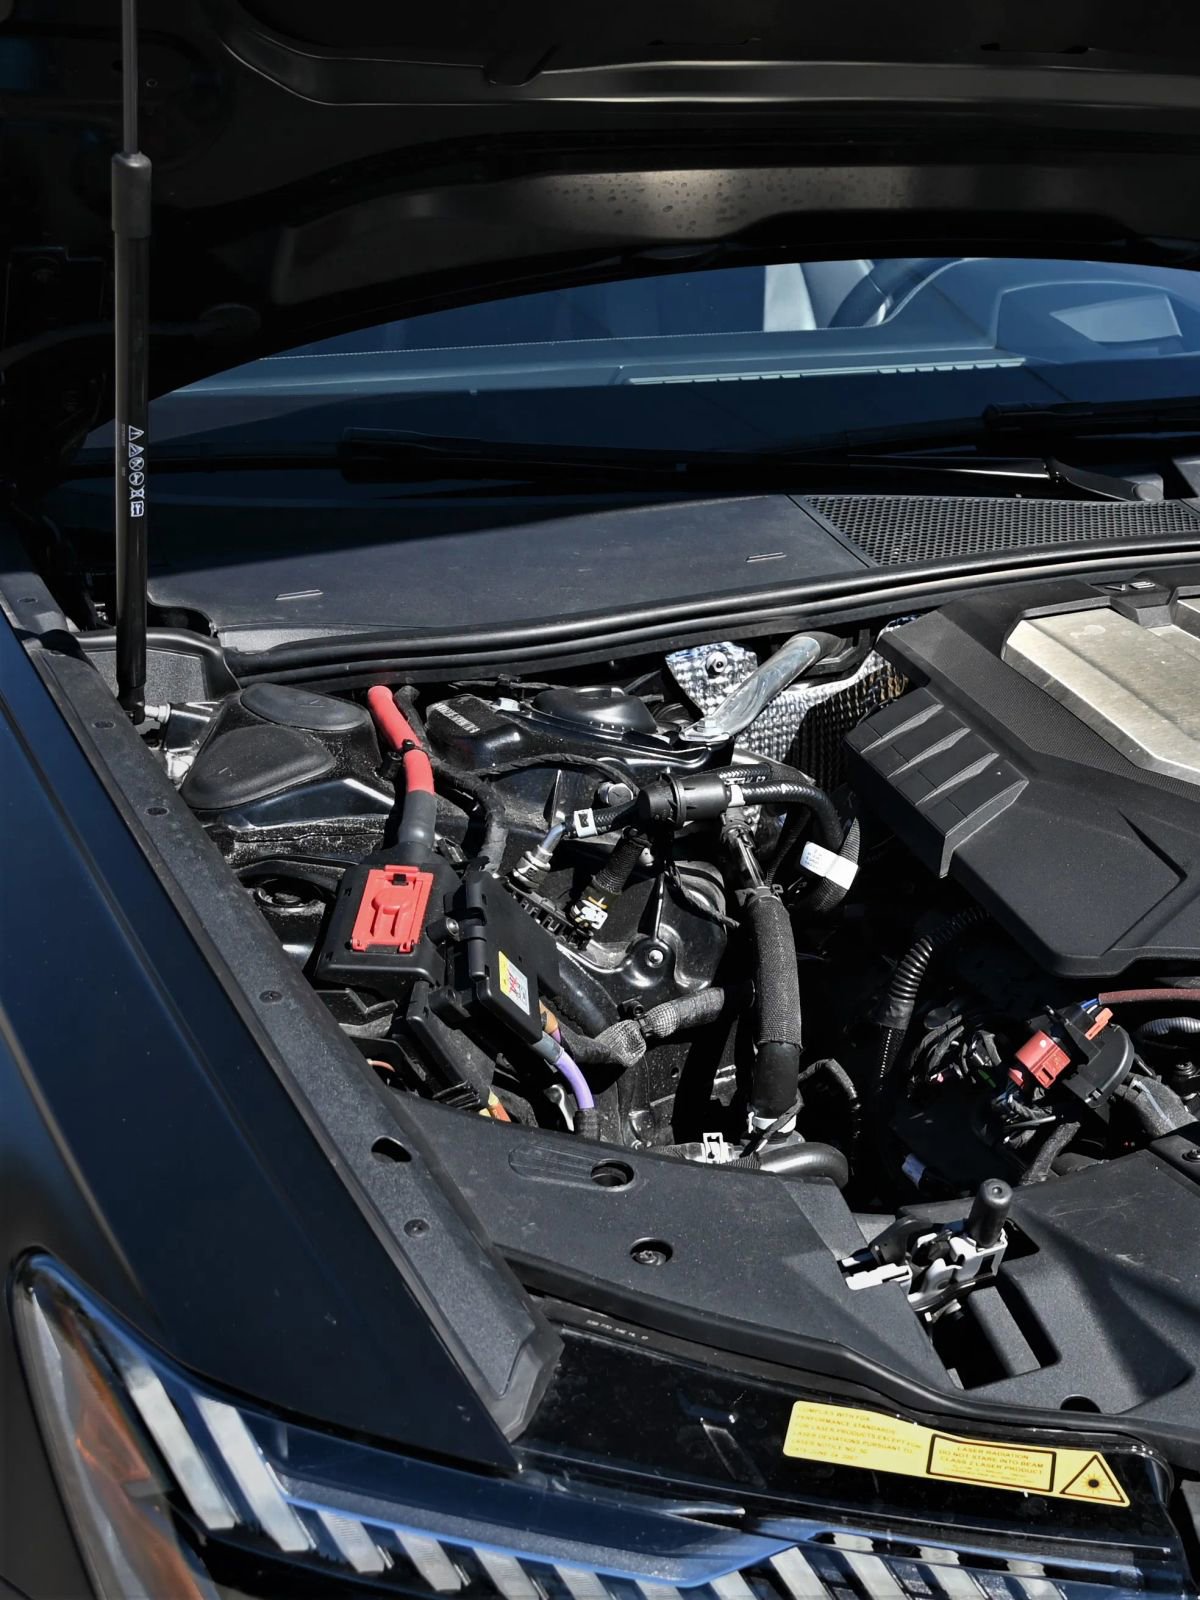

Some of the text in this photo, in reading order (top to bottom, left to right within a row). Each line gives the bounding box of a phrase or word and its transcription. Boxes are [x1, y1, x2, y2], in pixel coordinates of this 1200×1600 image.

[957, 1446, 1030, 1460] LASER RADIATION
[940, 1456, 967, 1466] CLASS
[976, 1461, 1002, 1470] LASER
[1004, 1464, 1042, 1475] PRODUCT
[972, 1454, 998, 1463] STARE
[999, 1457, 1019, 1466] INTO
[1021, 1460, 1044, 1468] BEAM
